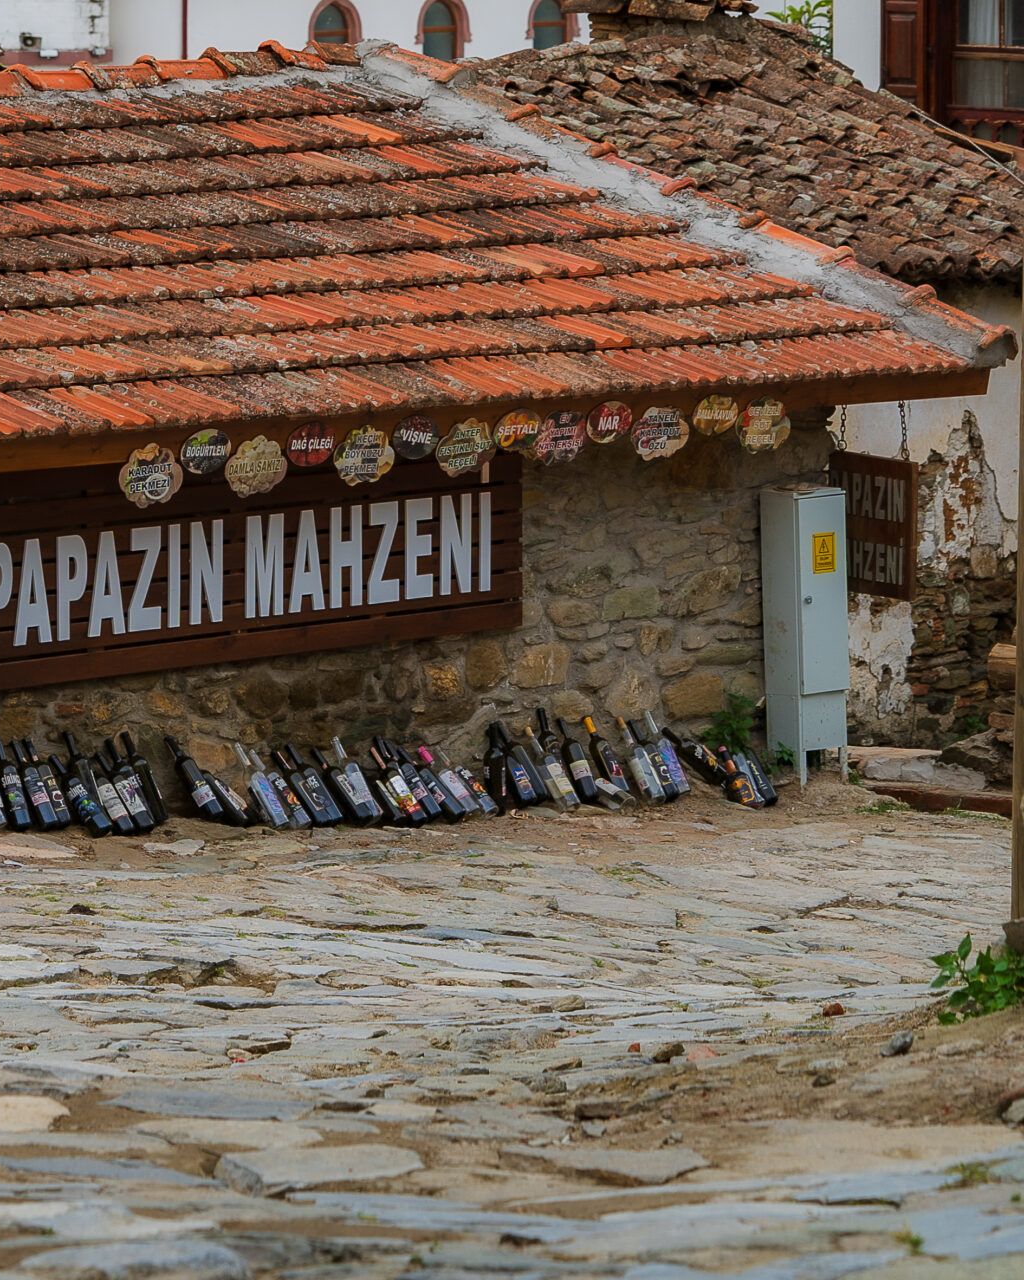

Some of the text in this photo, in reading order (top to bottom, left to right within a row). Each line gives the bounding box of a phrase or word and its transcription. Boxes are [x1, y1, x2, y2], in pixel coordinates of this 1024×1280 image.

[559, 414, 572, 424] EV
[598, 415, 620, 431] NAR
[648, 411, 680, 424] TANELİ
[402, 428, 432, 445] VİŞNE
[454, 428, 481, 441] ANTEP
[497, 421, 539, 438] ŞEFTALİ
[549, 426, 578, 437] YAPIMI
[291, 436, 334, 452] DAĞ ÇİLEĞİ
[438, 442, 474, 457] FISTIKLI
[537, 441, 555, 451] NAR
[344, 448, 385, 460] BOYNUZU
[448, 454, 478, 469] REÇELİ
[128, 463, 173, 478] KARADUT
[228, 461, 254, 476] DAMLA
[129, 477, 170, 494] PEKMEZİ
